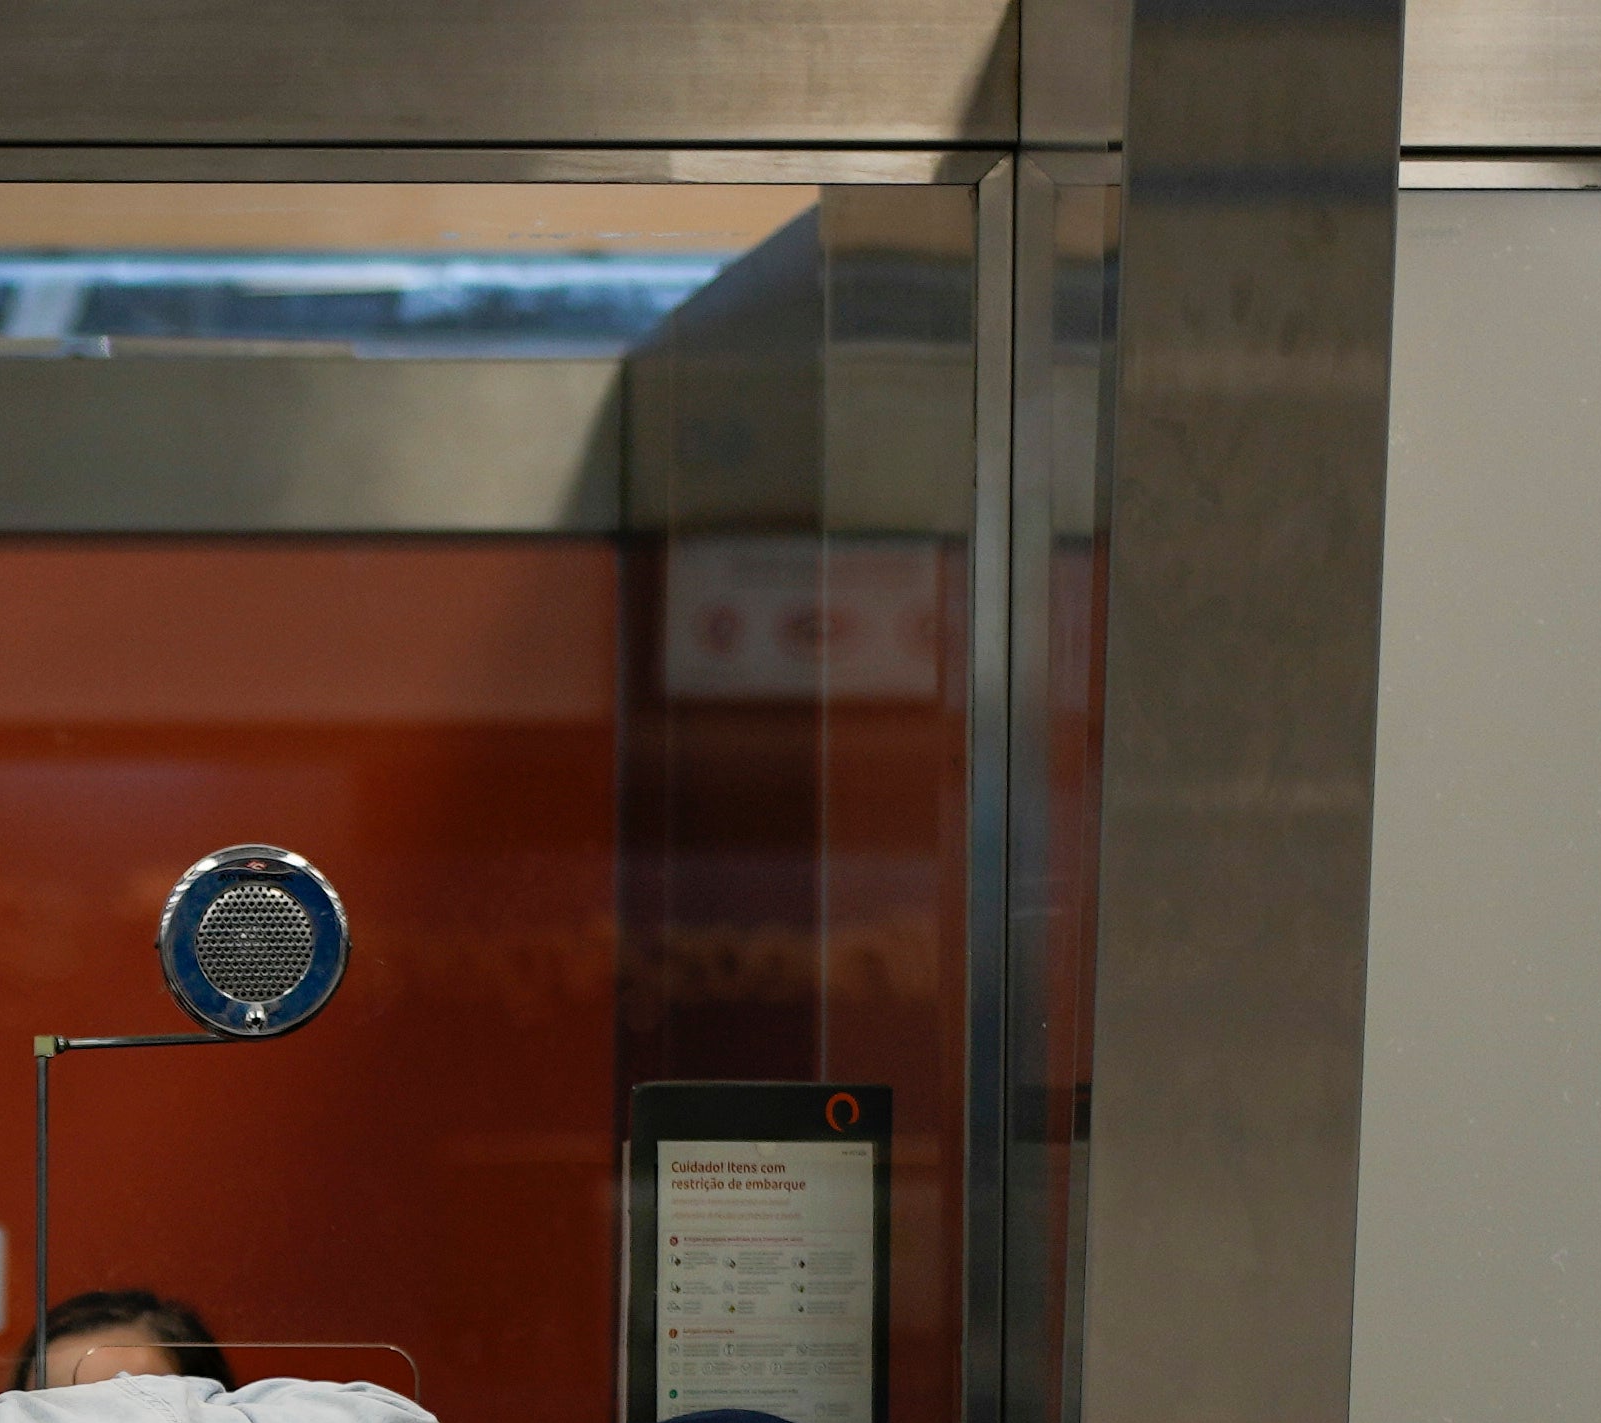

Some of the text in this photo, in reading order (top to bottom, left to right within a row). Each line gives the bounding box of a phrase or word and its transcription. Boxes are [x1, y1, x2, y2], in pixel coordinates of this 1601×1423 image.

[671, 1160, 786, 1174] Cuidado! Itens com
[671, 1177, 807, 1193] restrição de embarque
